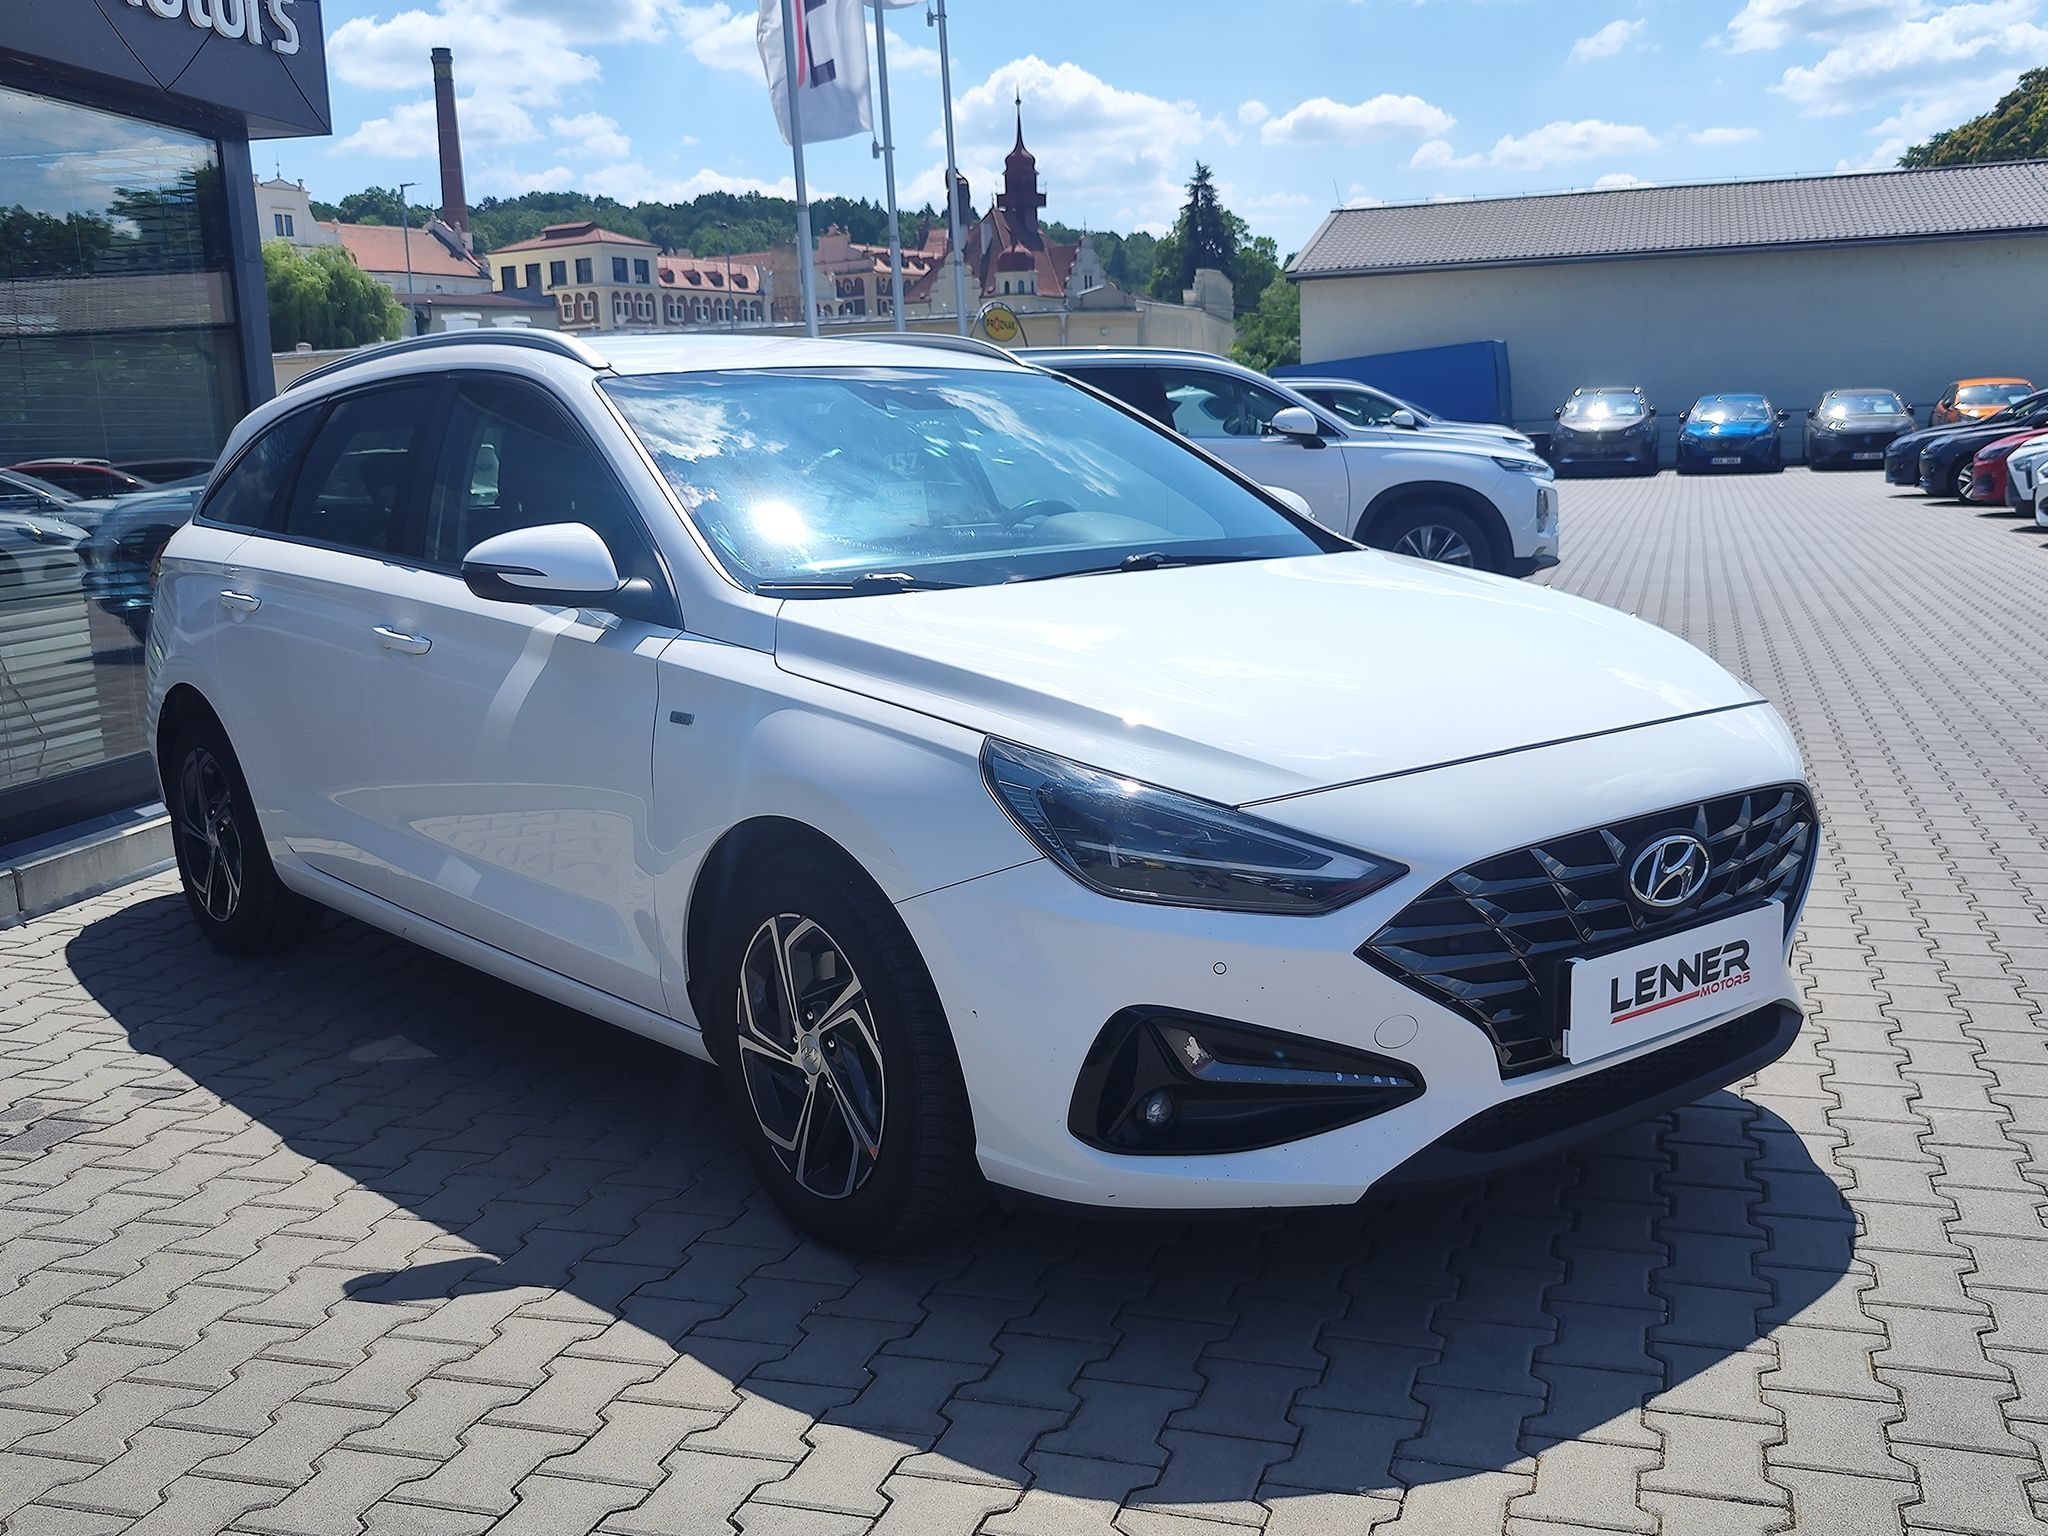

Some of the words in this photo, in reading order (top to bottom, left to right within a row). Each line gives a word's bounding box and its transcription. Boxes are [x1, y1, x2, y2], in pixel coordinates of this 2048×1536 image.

[126, 0, 300, 55] ors
[1610, 939, 1751, 1014] LENNER
[1699, 971, 1751, 998] MOTORS
